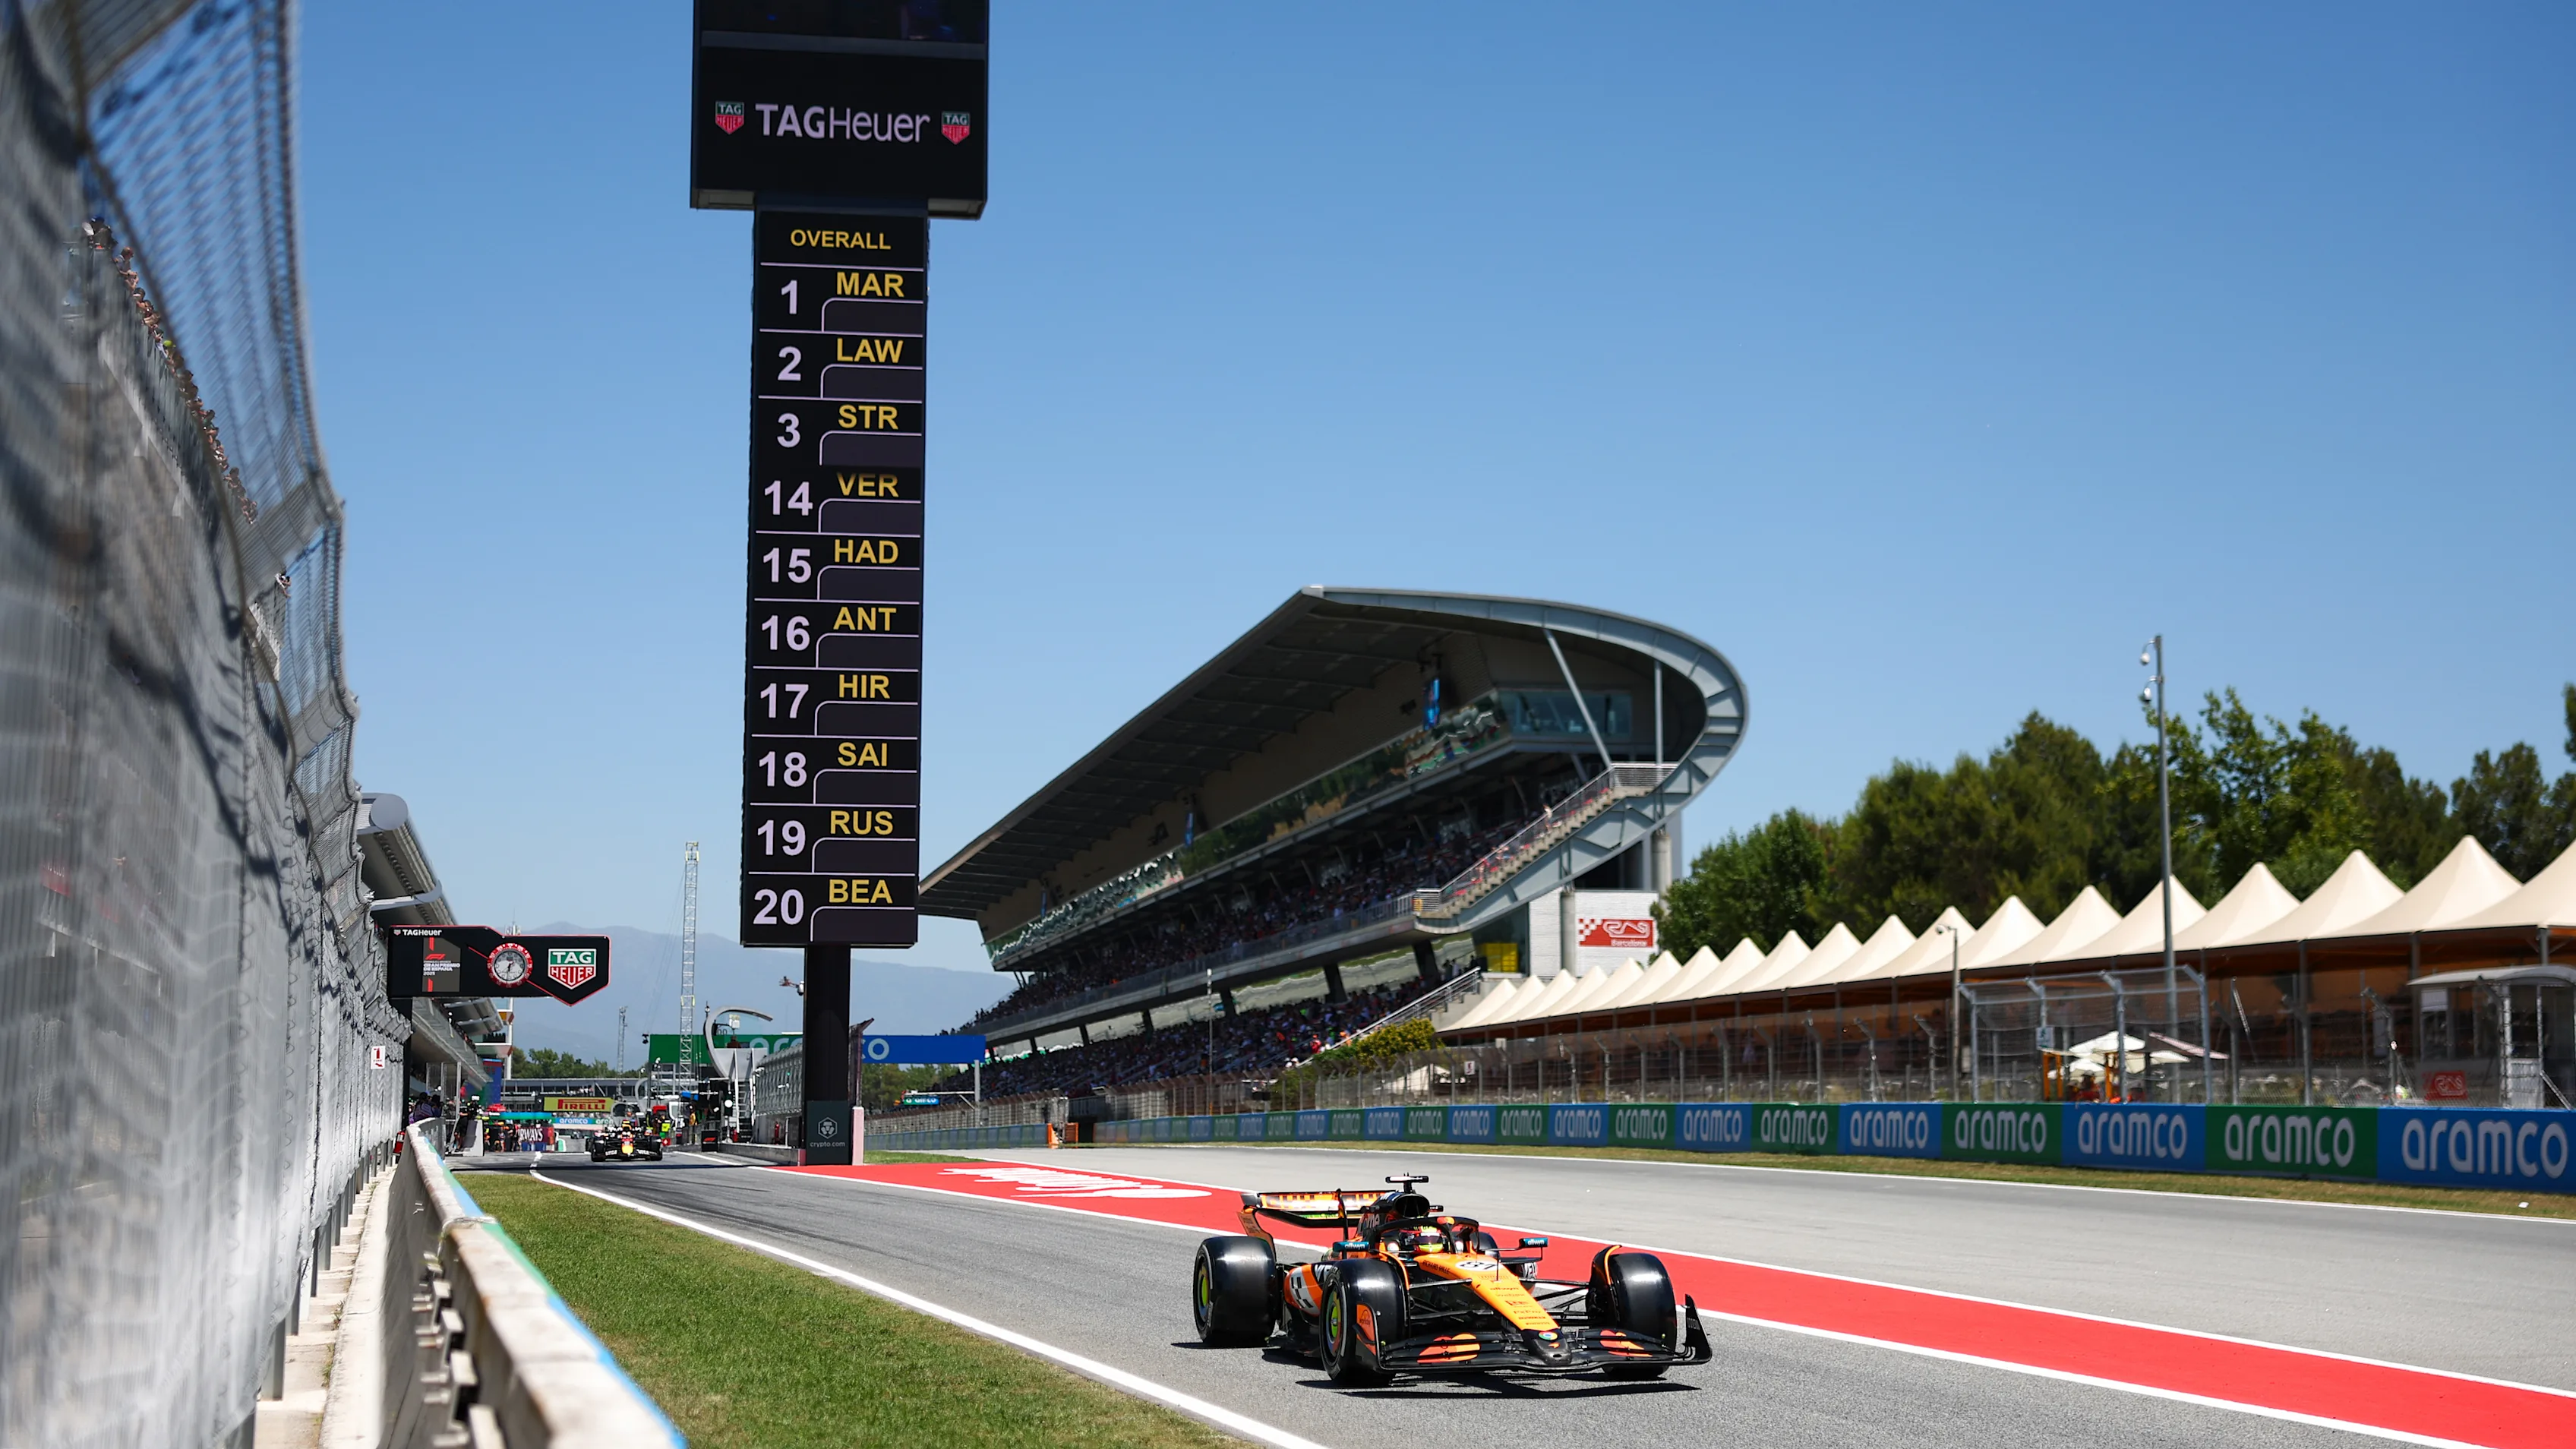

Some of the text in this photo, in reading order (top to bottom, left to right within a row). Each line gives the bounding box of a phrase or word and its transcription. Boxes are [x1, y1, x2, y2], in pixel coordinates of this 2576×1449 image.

[791, 229, 892, 250] OVERALL
[781, 279, 797, 314] 1
[836, 272, 904, 297] MAR
[777, 346, 802, 381] 2
[837, 338, 904, 363] LAW
[776, 412, 801, 448] 3
[838, 404, 899, 430] STR
[764, 480, 813, 516] 14
[836, 472, 899, 497] VER
[762, 547, 812, 583] 15
[834, 538, 899, 564] HAD
[762, 614, 810, 651] 16
[833, 606, 897, 631] ANT
[760, 683, 809, 718] 17
[838, 674, 891, 699] HIR
[759, 751, 807, 788] 18
[837, 742, 888, 767] SAI
[757, 819, 806, 856] 19
[830, 810, 893, 835] RUS
[753, 889, 804, 925] 20
[829, 879, 893, 904] BEA
[552, 952, 592, 964] TAG
[551, 967, 593, 986] HEUER
[557, 1099, 606, 1110] PIRELLI
[1452, 1110, 1490, 1137] aramco
[1500, 1109, 1542, 1138] aramco
[1554, 1109, 1602, 1139] aramco
[1615, 1109, 1668, 1140] aramco
[1683, 1109, 1743, 1143] aramco
[1760, 1109, 1829, 1146] aramco
[1849, 1110, 1929, 1150] aramco
[1955, 1110, 2047, 1154] aramco
[2078, 1111, 2187, 1160] aramco
[2224, 1113, 2355, 1168] aramco
[2401, 1118, 2568, 1179] aramco
